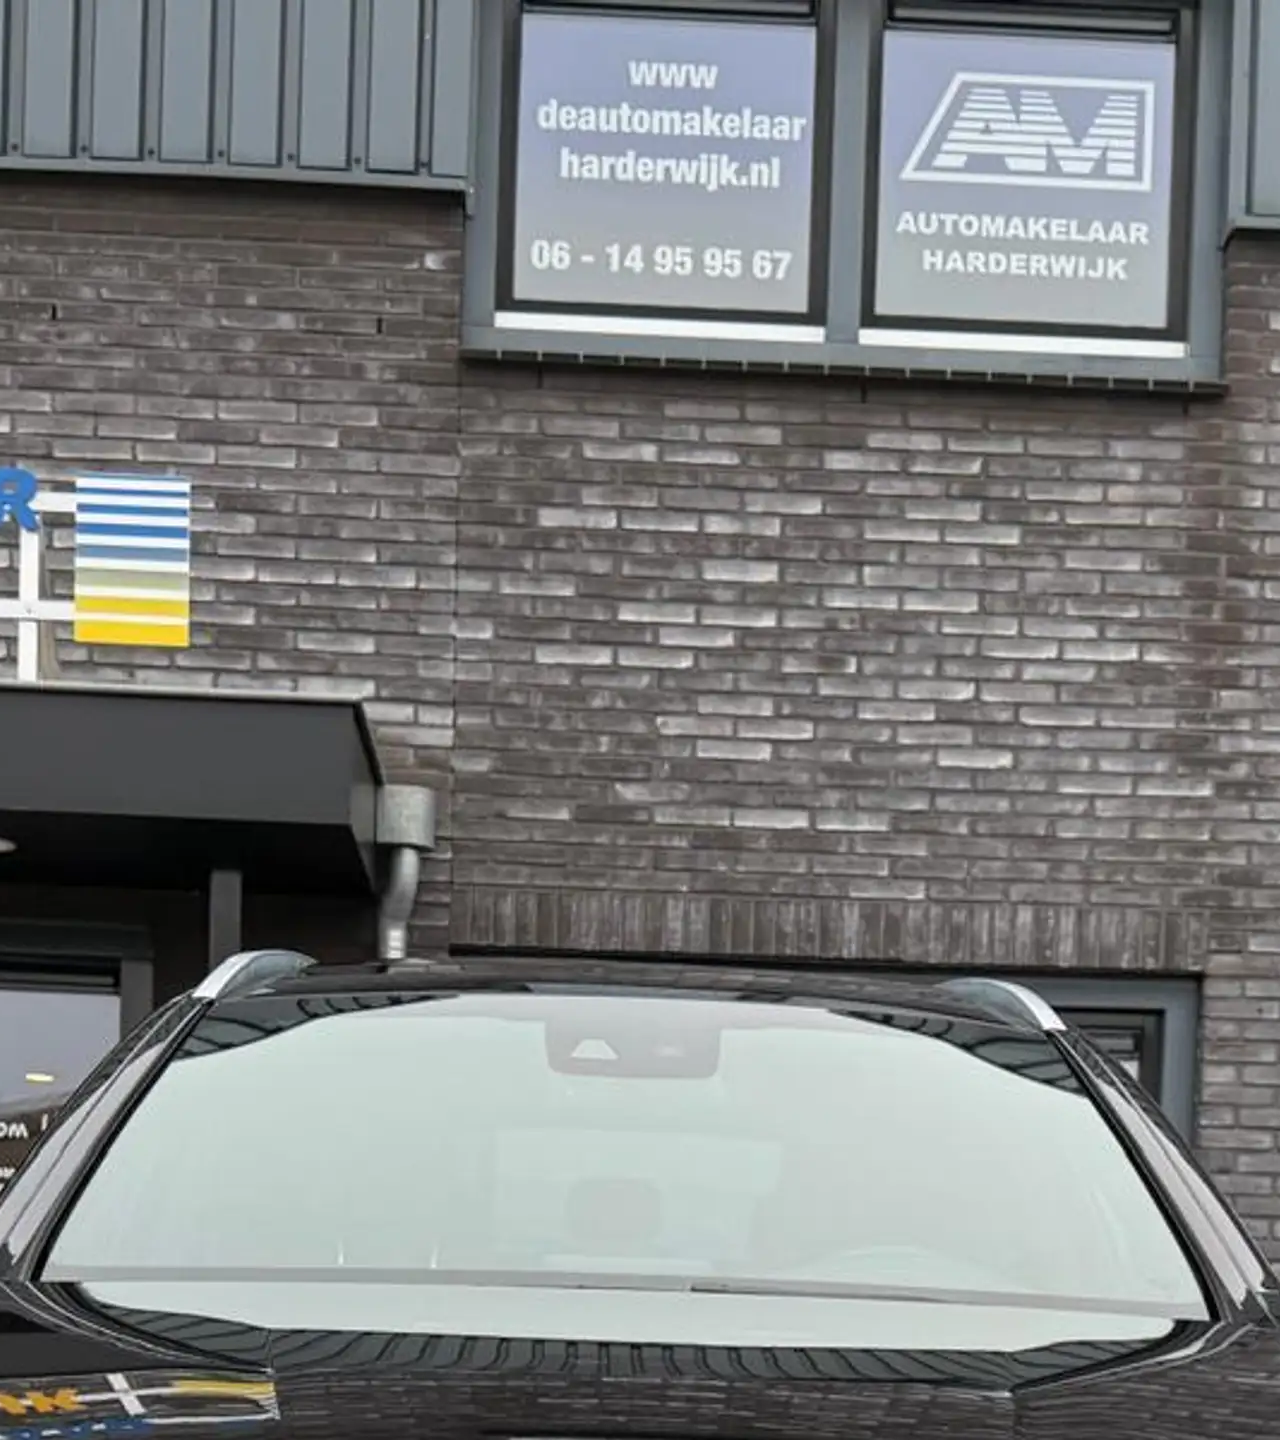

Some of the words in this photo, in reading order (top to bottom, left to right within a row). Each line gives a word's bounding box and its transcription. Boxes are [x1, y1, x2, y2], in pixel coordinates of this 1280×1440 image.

[629, 60, 718, 88] www
[537, 99, 807, 141] deautomakelaar
[560, 147, 781, 191] harderwijk.nl
[896, 211, 1150, 245] AUTOMAKELAAR
[531, 239, 570, 270] 06
[606, 243, 644, 274] 14
[654, 245, 693, 276] 95
[703, 248, 742, 278] 95
[752, 250, 793, 281] 67
[922, 249, 1129, 281] HARDERWIJK
